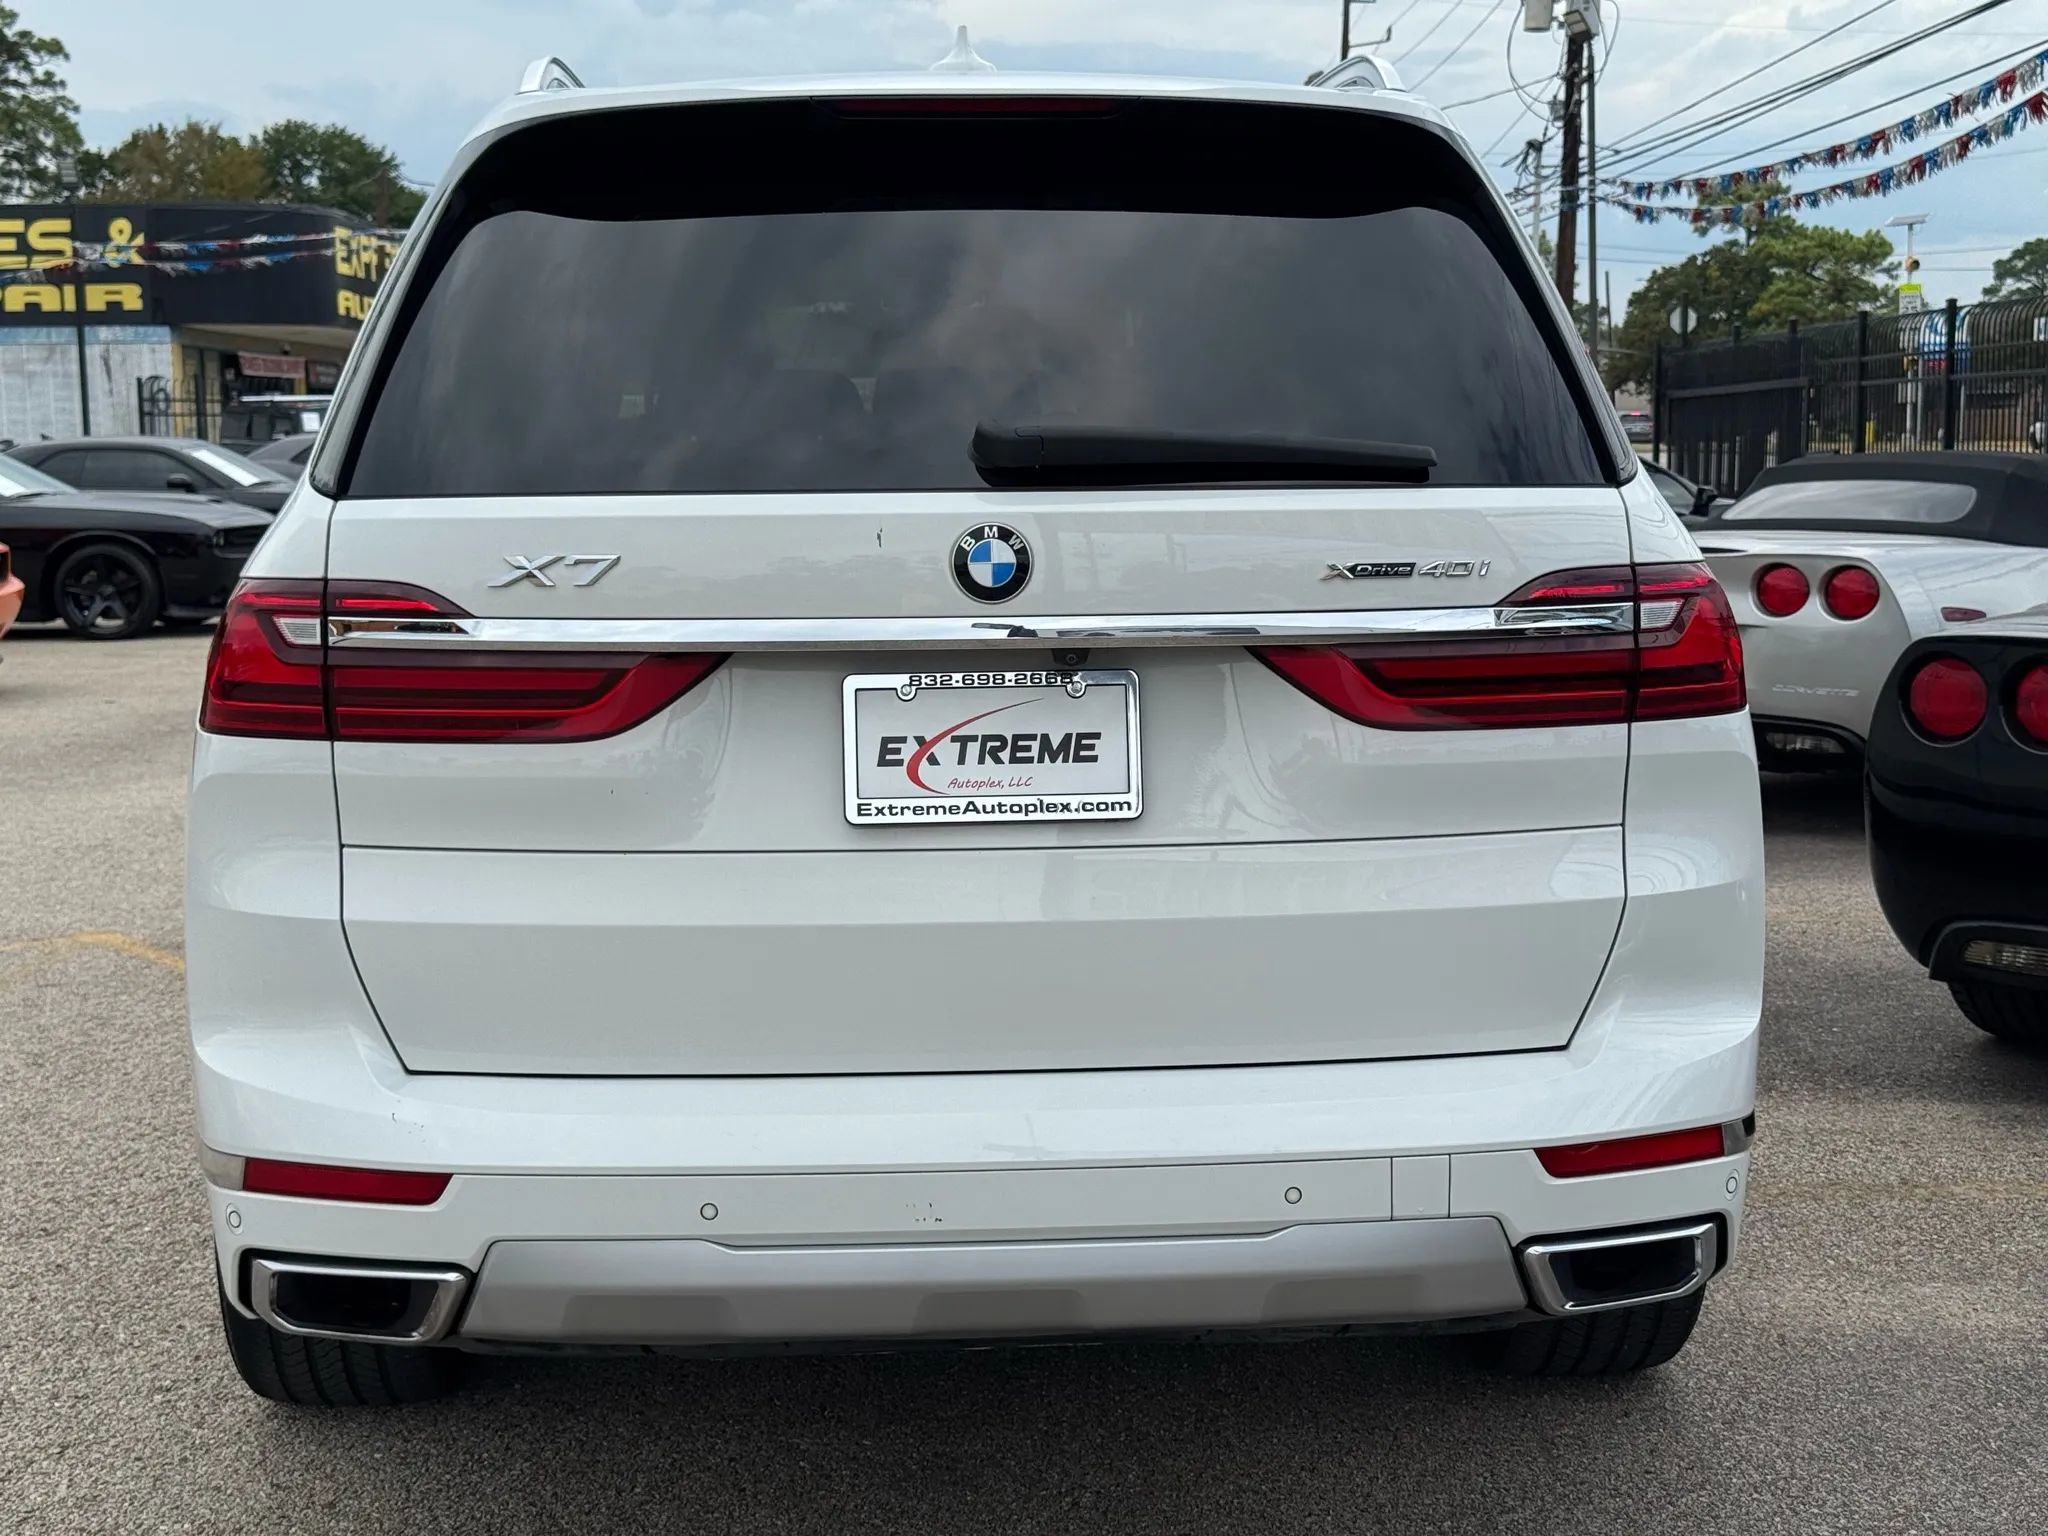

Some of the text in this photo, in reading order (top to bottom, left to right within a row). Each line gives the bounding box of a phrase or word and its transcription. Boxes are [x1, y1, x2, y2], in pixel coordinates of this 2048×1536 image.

[0, 283, 144, 312] AIR
[960, 526, 1025, 551] BMW
[488, 554, 621, 587] X7
[1418, 560, 1491, 578] 40i
[876, 732, 1102, 767] EXTREME
[947, 776, 1034, 790] Autoplex, LLC
[856, 798, 1132, 818] ExtremeAutoplex.com
